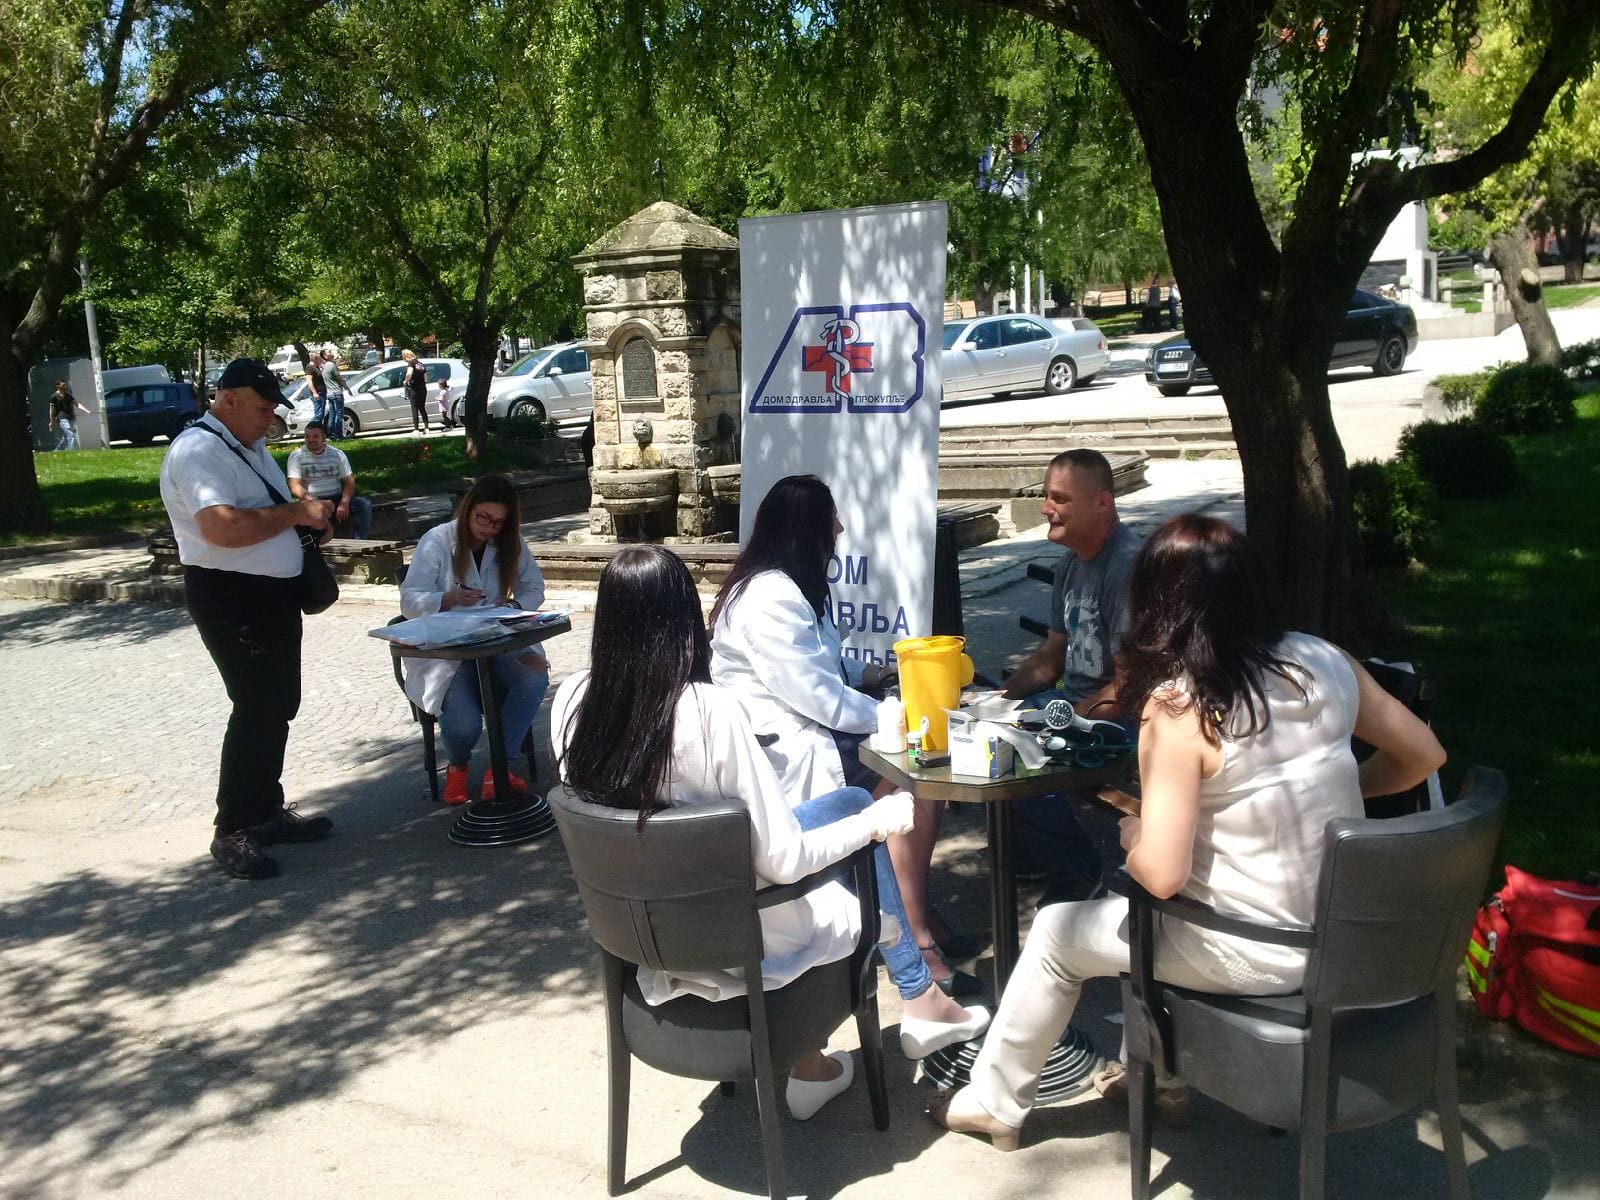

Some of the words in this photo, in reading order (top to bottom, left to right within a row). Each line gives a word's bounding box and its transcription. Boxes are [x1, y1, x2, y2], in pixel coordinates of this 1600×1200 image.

[763, 395, 784, 405] ДОМ
[786, 395, 832, 405] ЗДРАВЉА
[855, 394, 905, 403] ПРОКУПЉЕ
